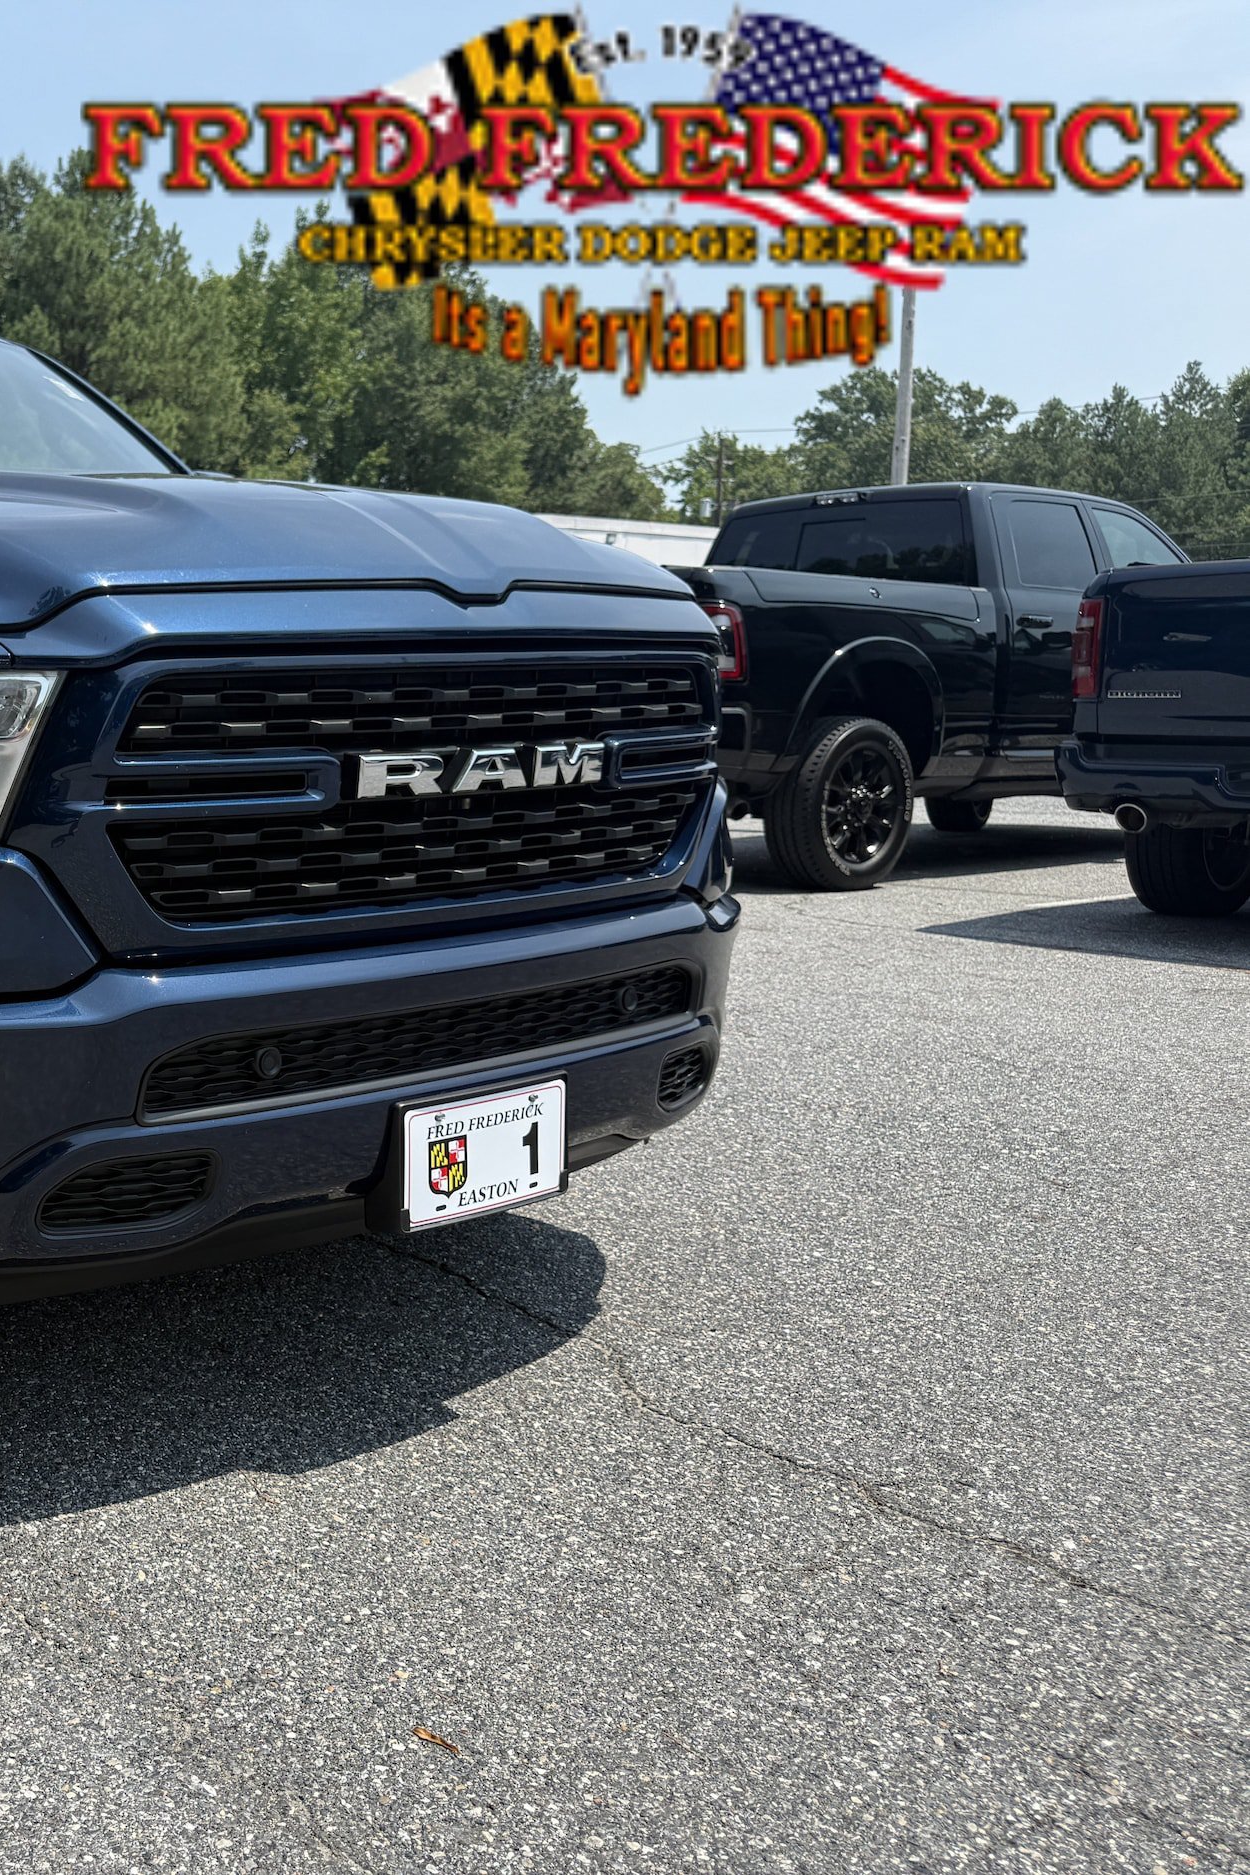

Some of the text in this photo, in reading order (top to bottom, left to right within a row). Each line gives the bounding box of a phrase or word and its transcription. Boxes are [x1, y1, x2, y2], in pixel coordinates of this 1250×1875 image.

[356, 741, 605, 799] RAM
[426, 1102, 545, 1141] FRED FREDERICK
[522, 1121, 539, 1176] 1
[457, 1179, 519, 1208] EASTON
